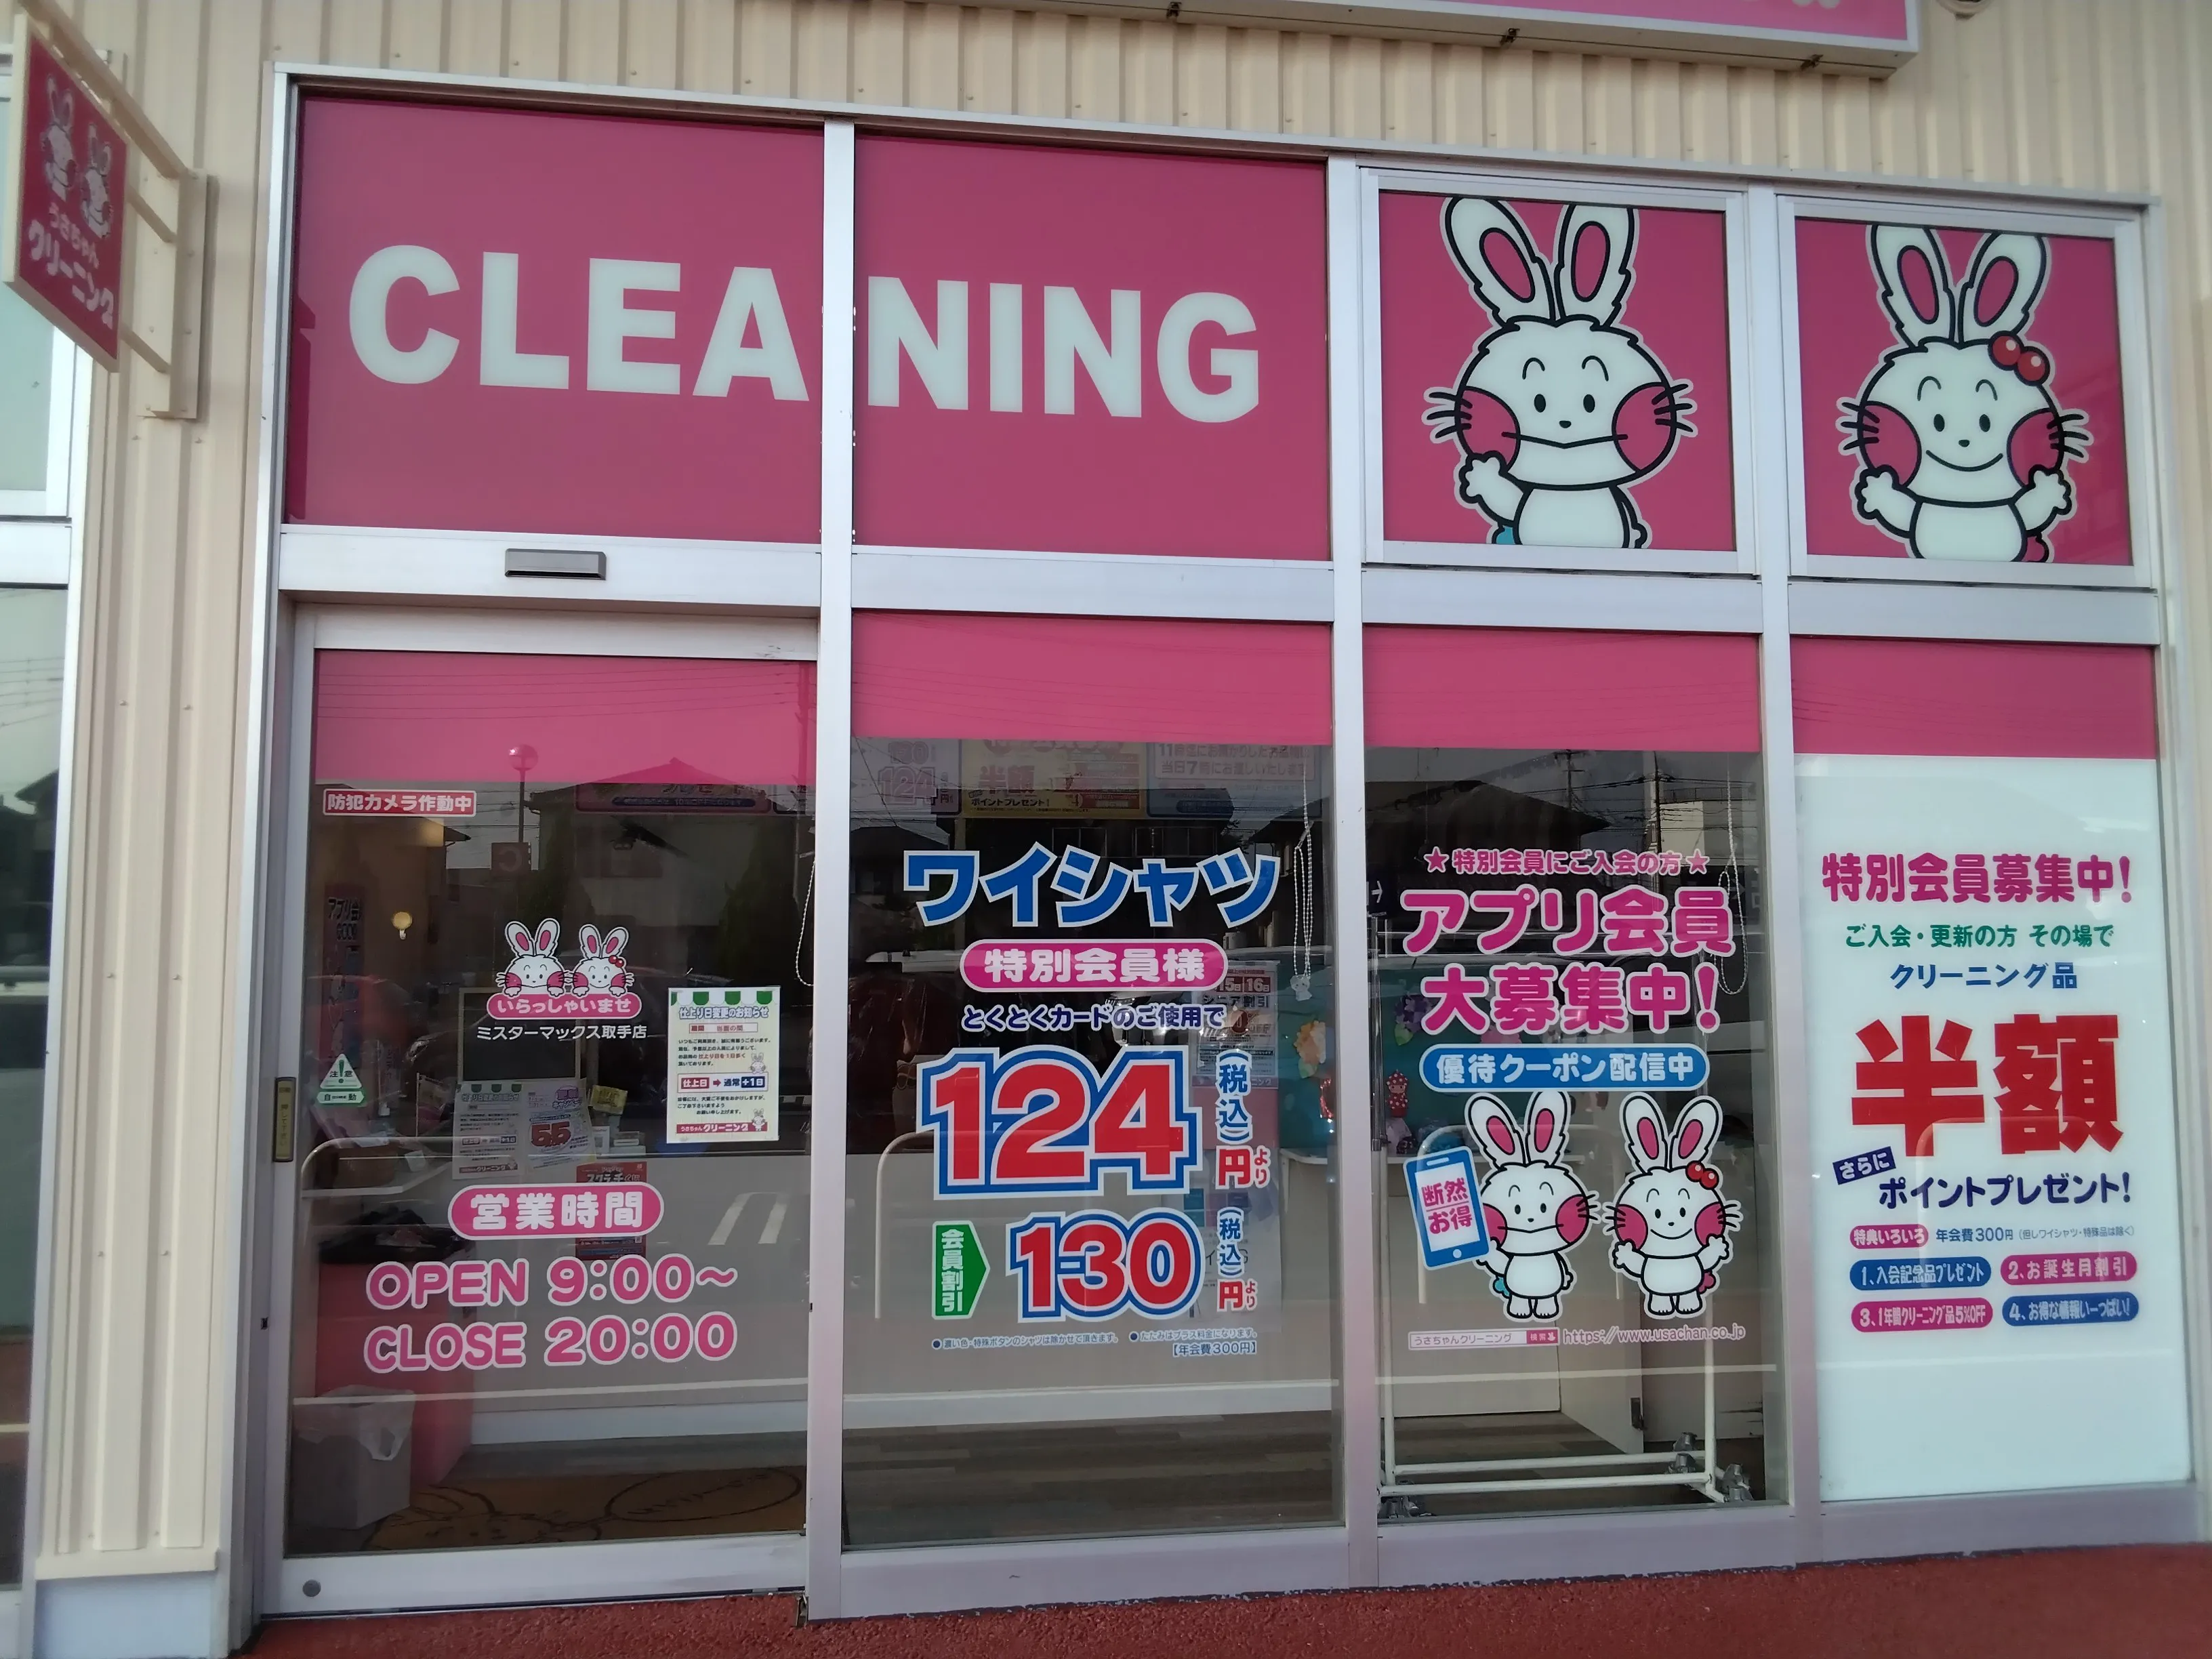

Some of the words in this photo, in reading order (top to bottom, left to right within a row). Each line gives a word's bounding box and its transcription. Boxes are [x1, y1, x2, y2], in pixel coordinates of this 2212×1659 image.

[28, 220, 114, 329] クリーニング
[348, 245, 1258, 422] CLEANING
[327, 794, 472, 813] 防犯カメラ作動中
[1452, 848, 1682, 876] 特別会員にご入会の方
[1822, 852, 2132, 904] 特別会員募集中!
[903, 842, 1280, 928] ワイシャツ
[1400, 884, 1735, 957] アプリ会員
[1845, 923, 2018, 948] ご入会・更新の方
[2028, 923, 2114, 947] その場で
[984, 947, 1206, 983] 特別会員様
[1889, 962, 2078, 989] クリーニング品
[497, 998, 632, 1014] いらっしゃいませ
[679, 1006, 769, 1019] 仕上り日変更のお知らせ
[1420, 962, 1721, 1035] 大募集中!
[476, 1024, 647, 1041] ミスターマックス取手店
[962, 1004, 1226, 1032] とくとくカードのご使用で
[682, 1079, 708, 1088] 仕上日
[1436, 1052, 1694, 1085] 優待クーポン配信中
[1851, 1013, 2123, 1157] 半額
[917, 1045, 1203, 1200] 124
[1839, 1151, 1891, 1181] さらに
[1420, 1176, 1469, 1207] 断然
[1879, 1172, 2131, 1209] ポイントプレゼント!
[470, 1191, 644, 1230] 営業時間
[1428, 1204, 1474, 1235] お得
[1853, 1227, 1925, 1246] 特典いろいろ
[1936, 1227, 2013, 1242] 年会費300円
[941, 1228, 964, 1313] 会員割引
[1006, 1207, 1206, 1324] 130
[367, 1258, 529, 1309] OPEN
[364, 1322, 527, 1374] CLOSE
[544, 1311, 738, 1368] 20:00
[1414, 1333, 1512, 1345] うさちゃんクリーニング
[1563, 1324, 1746, 1345] https://www.usachan.co.jp
